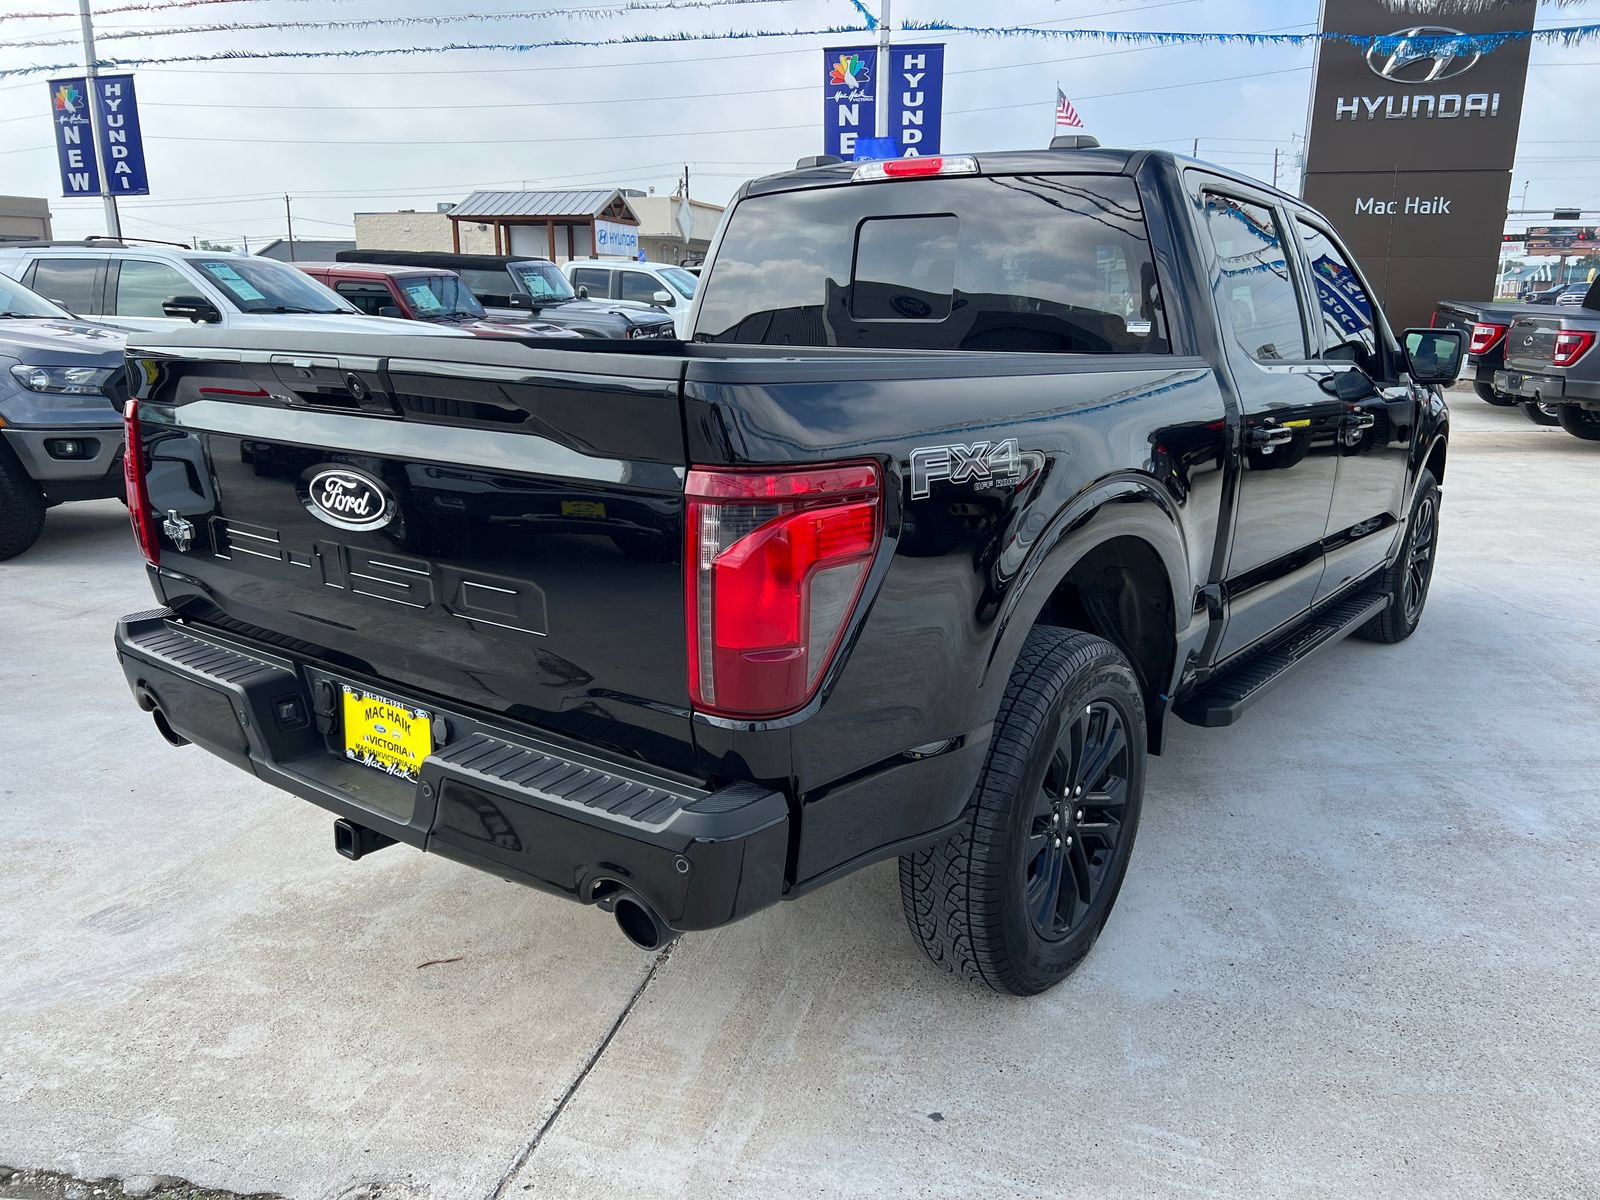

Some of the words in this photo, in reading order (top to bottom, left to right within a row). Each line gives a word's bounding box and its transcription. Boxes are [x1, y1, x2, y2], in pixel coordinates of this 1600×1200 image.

[902, 54, 926, 157] HYUNDA
[1335, 93, 1500, 120] HYUNDAI
[105, 84, 132, 189] HYUNDAI
[838, 104, 859, 155] NE
[64, 126, 89, 191] NEW
[1354, 198, 1397, 215] Mac
[1404, 197, 1451, 215] Haik
[609, 231, 637, 247] HYUNDAI
[909, 438, 1021, 500] FX4
[974, 481, 994, 491] OFF
[995, 477, 1020, 488] ROAD
[321, 476, 370, 516] Ford
[207, 515, 549, 637] F-150
[365, 707, 384, 721] MAC
[387, 709, 411, 736] HAIK
[370, 735, 408, 756] VICTORIA
[362, 753, 386, 771] Mac
[386, 762, 416, 782] Haik
